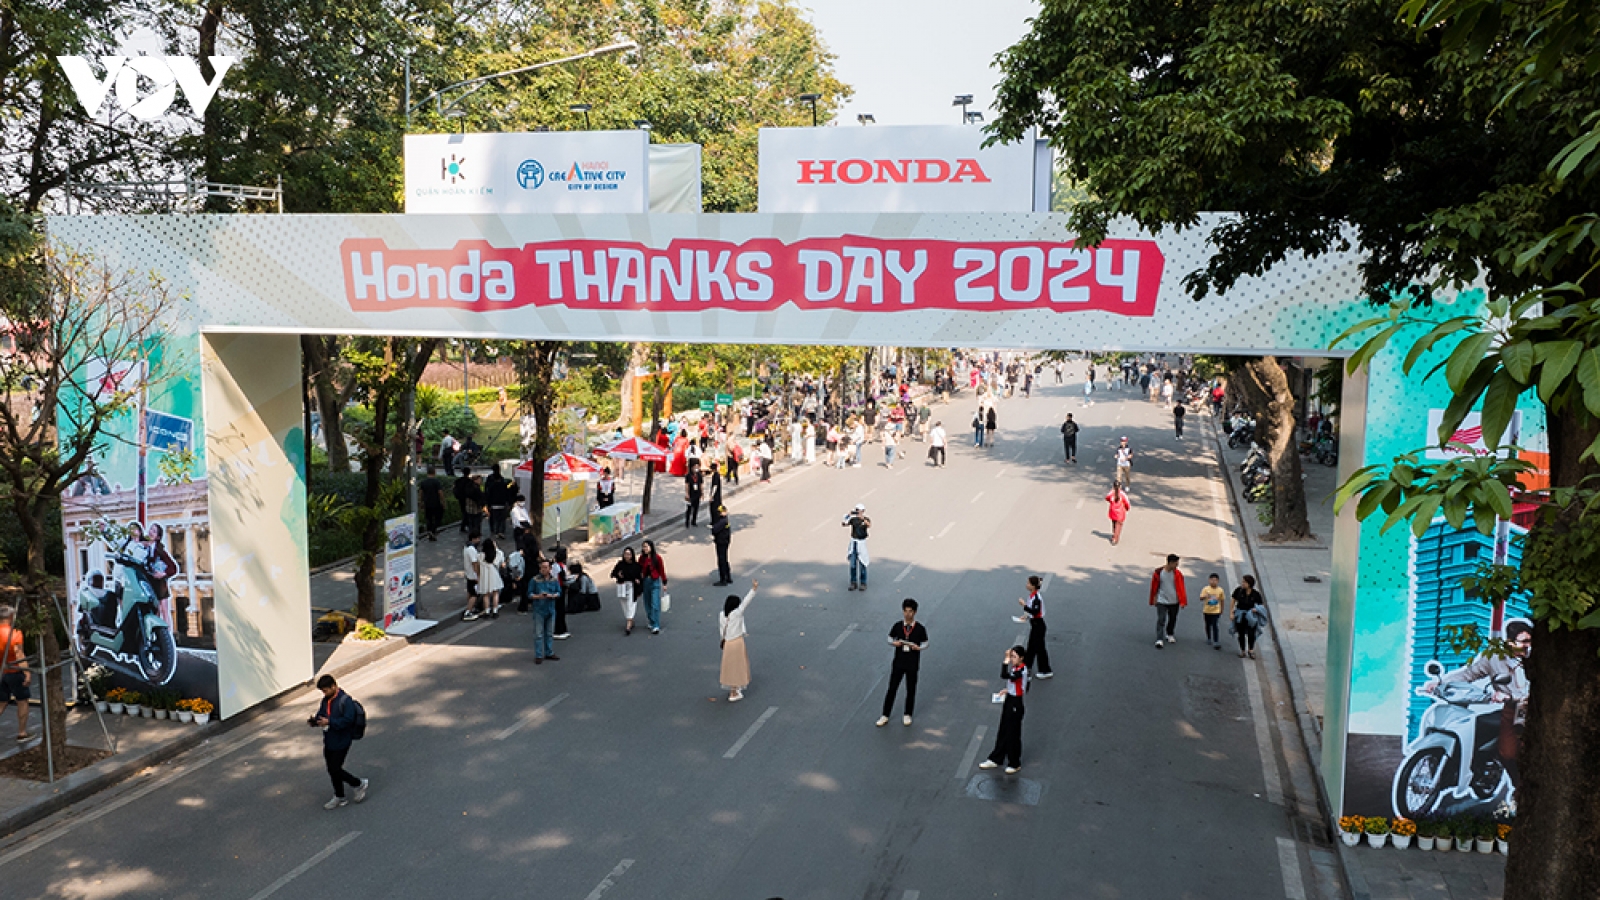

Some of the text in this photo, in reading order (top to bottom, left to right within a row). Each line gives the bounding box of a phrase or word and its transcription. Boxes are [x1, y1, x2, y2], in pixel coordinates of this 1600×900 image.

[548, 161, 626, 181] CREATIVE CITY
[797, 158, 991, 184] HONDA
[348, 246, 1142, 305] Honda THANKS DAY 2024
